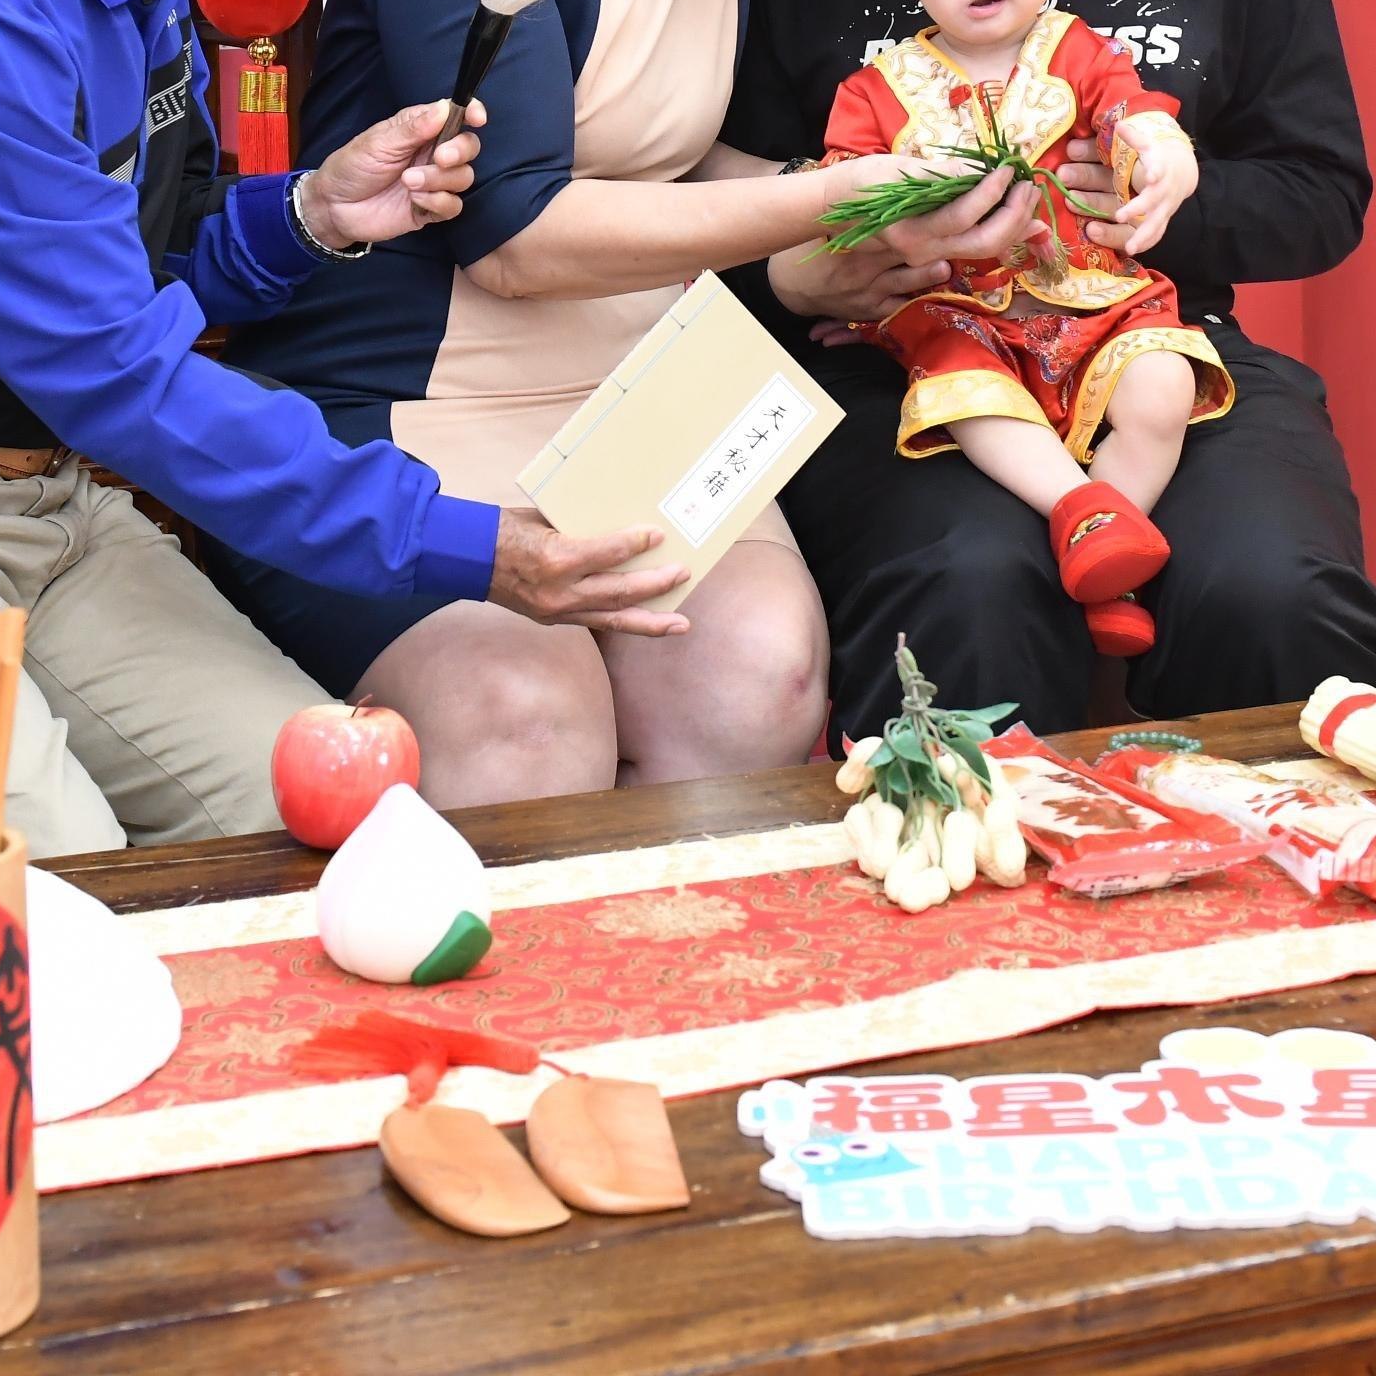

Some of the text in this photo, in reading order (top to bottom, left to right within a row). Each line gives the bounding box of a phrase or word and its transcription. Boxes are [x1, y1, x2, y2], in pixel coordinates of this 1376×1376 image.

[703, 405, 787, 498] 天才秘籍
[935, 1132, 1356, 1180] HAPPY
